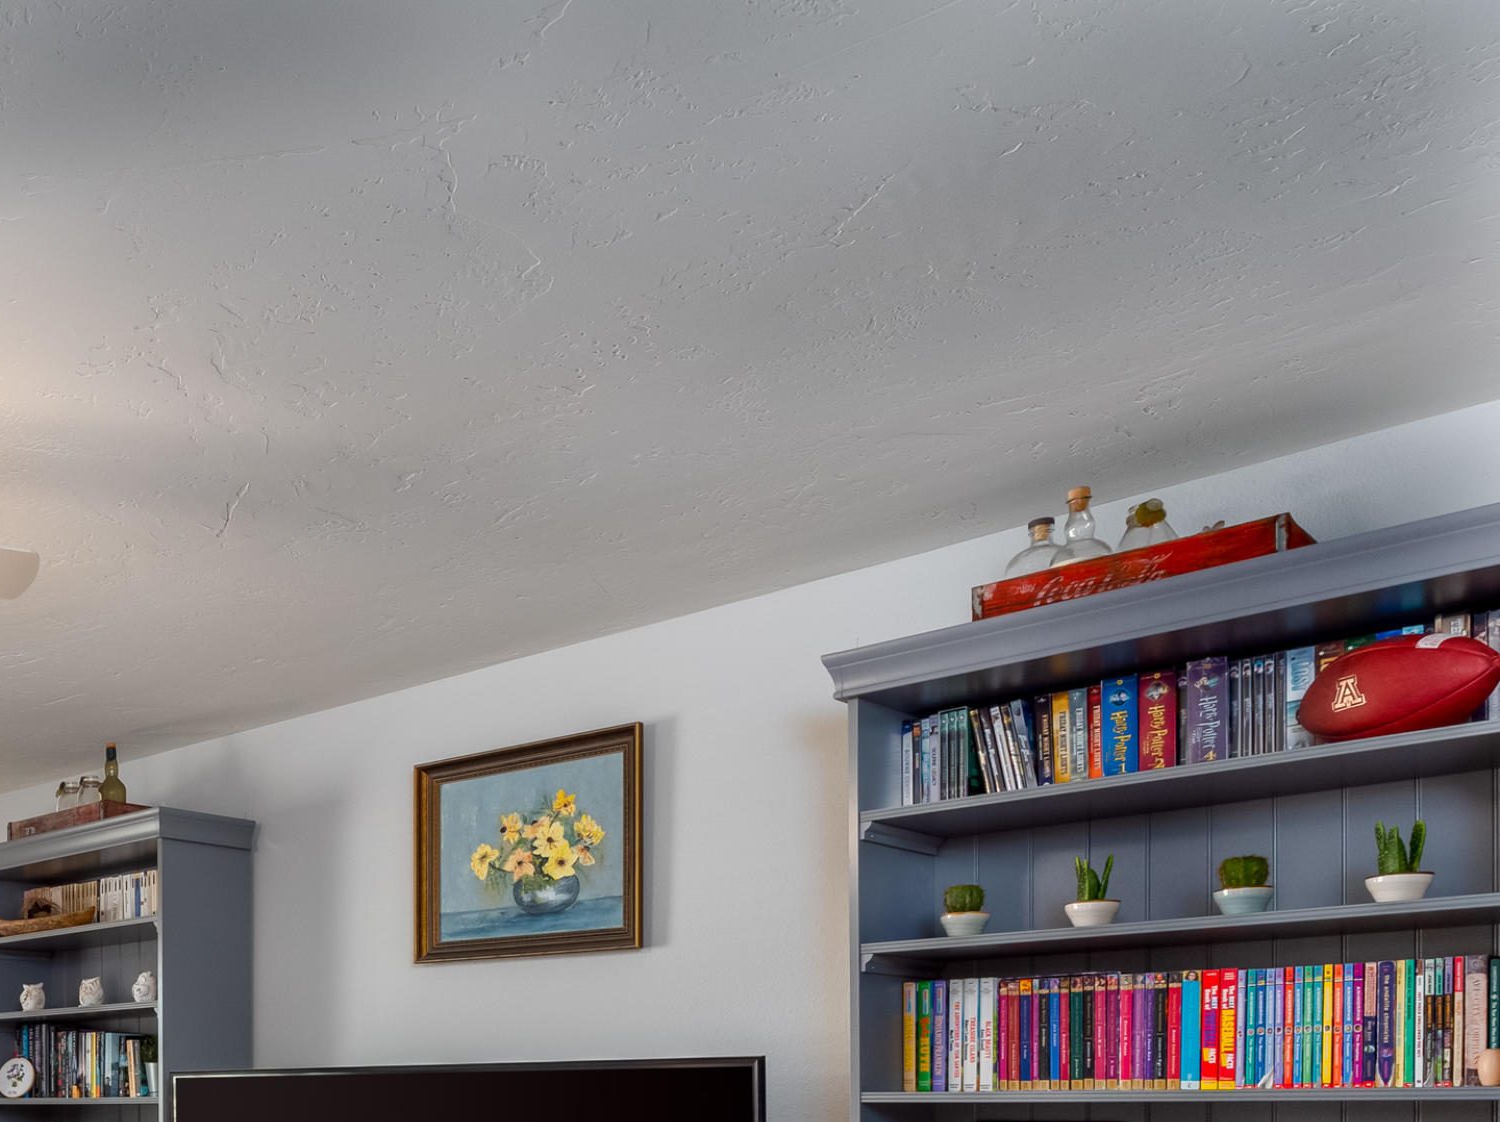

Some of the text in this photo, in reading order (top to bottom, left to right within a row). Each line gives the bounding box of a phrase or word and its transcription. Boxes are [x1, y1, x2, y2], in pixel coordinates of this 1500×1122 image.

[1332, 674, 1367, 712] A
[1148, 704, 1166, 729] Harry
[1198, 696, 1219, 720] Harry
[1110, 710, 1132, 761] Harry Potter
[1148, 729, 1169, 757] Potter
[1196, 720, 1221, 749] Potter
[1204, 1002, 1211, 1010] of
[1211, 985, 1219, 1009] The BEST
[1222, 1002, 1229, 1010] of
[1228, 985, 1236, 1009] The BEST
[1204, 1010, 1217, 1048] FOOTBALL
[1222, 1009, 1235, 1052] BASEBALL
